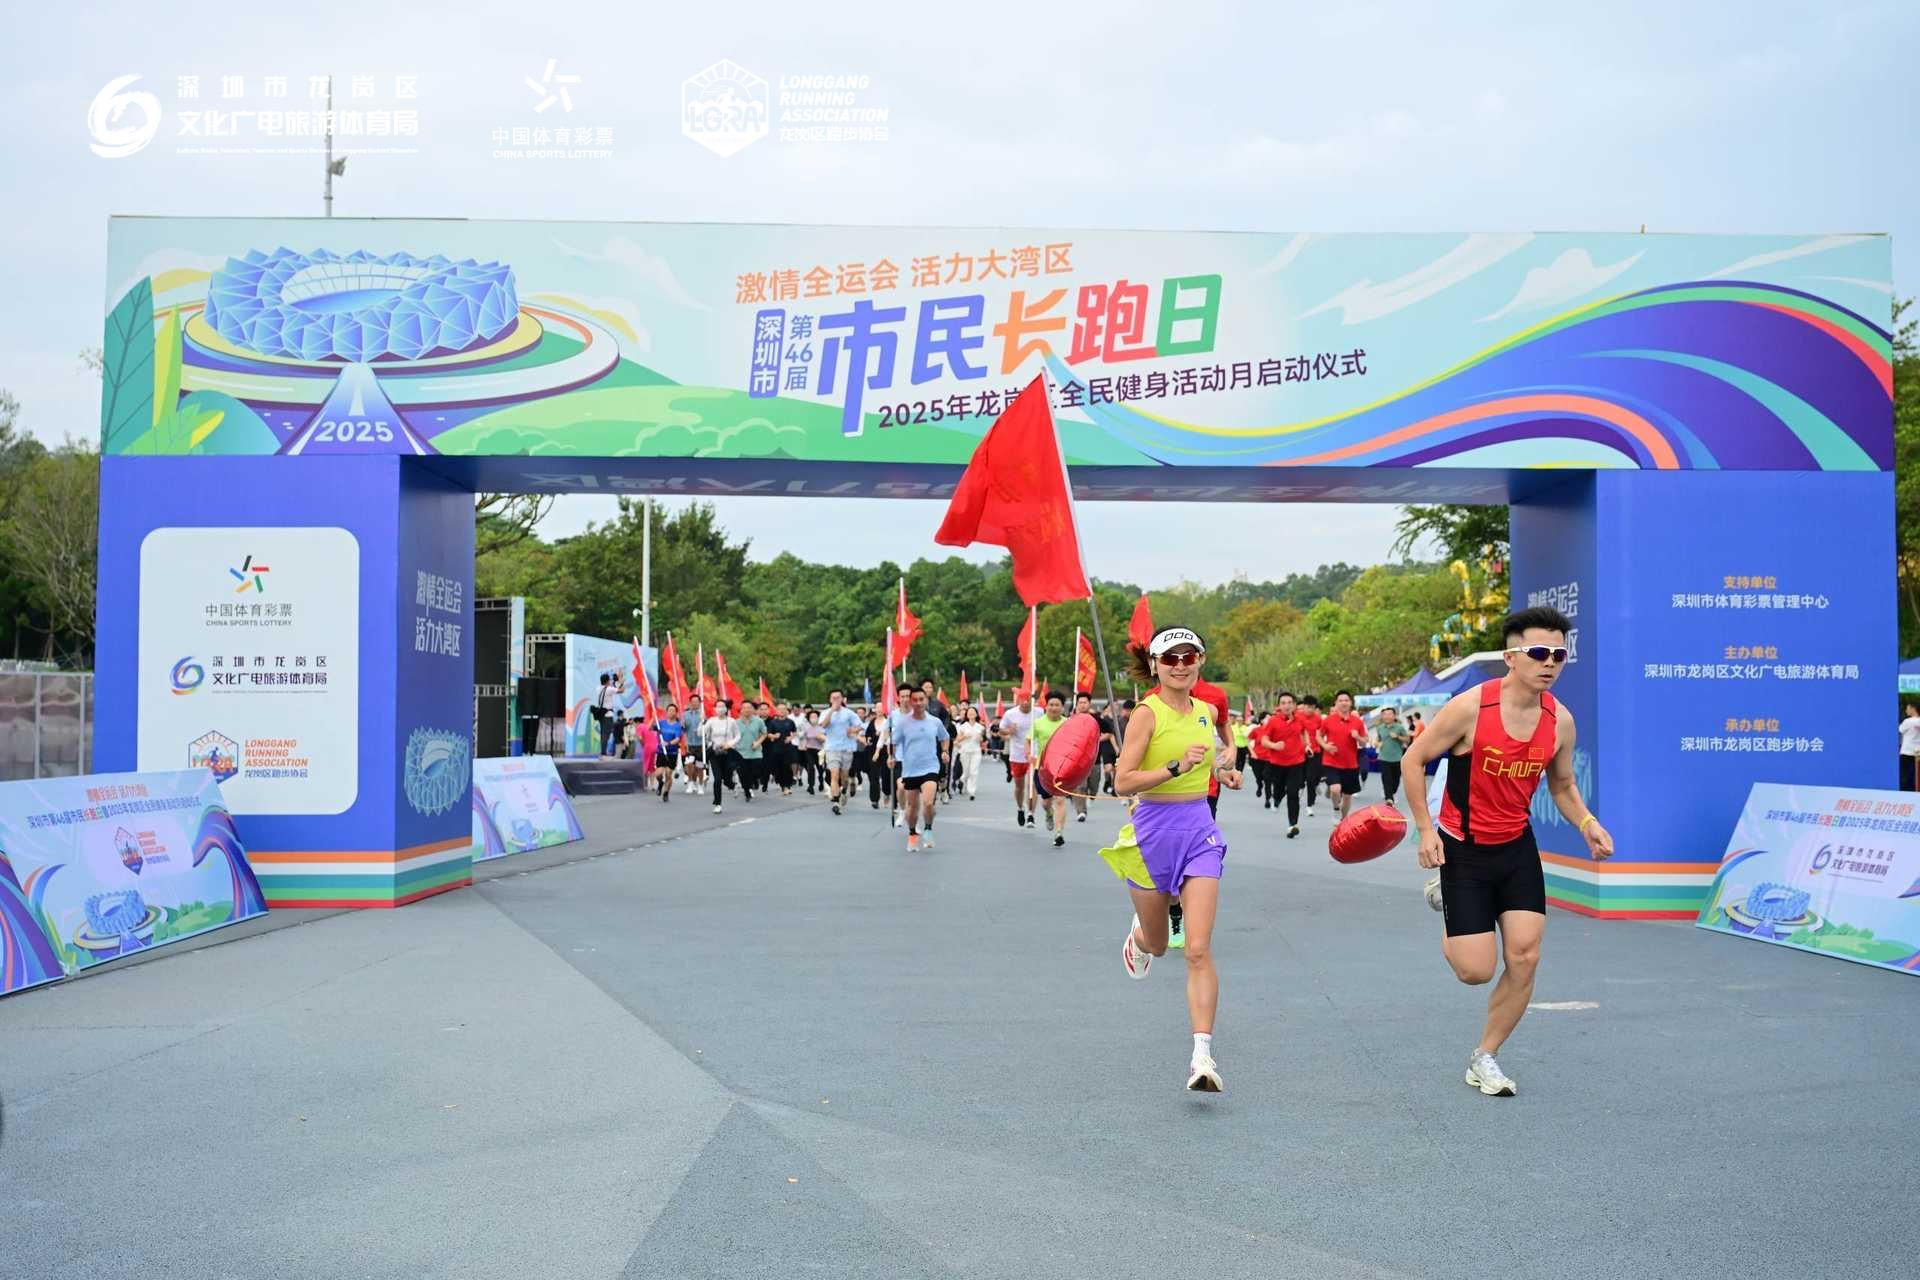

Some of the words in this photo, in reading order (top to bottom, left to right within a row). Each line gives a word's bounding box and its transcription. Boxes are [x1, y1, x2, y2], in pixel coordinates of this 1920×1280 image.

[736, 258, 900, 304] 激情全运会
[911, 243, 1073, 288] 活力大湾区
[753, 314, 783, 397] 深圳市
[817, 273, 1222, 435] 市民长跑日
[314, 420, 394, 442] 2025
[1723, 576, 1777, 589] 支持单位
[1672, 594, 1829, 609] 深圳市体育彩票管理中心
[205, 603, 292, 617] 中国体育彩票
[1724, 646, 1778, 660] 主办单位
[213, 656, 327, 667] 深圳市龙岗区
[212, 672, 327, 685] 文化广电旅游体育局
[1644, 664, 1859, 680] 深圳市龙岗区文化广电旅游体育局
[1725, 719, 1779, 732] 承办单位
[245, 739, 297, 748] LONGGANG
[1681, 737, 1824, 752] 深圳市龙岗区跑步协会
[245, 749, 289, 757] RUNNING
[245, 759, 308, 767] ASSOCIATION
[1482, 756, 1543, 778] CHINA
